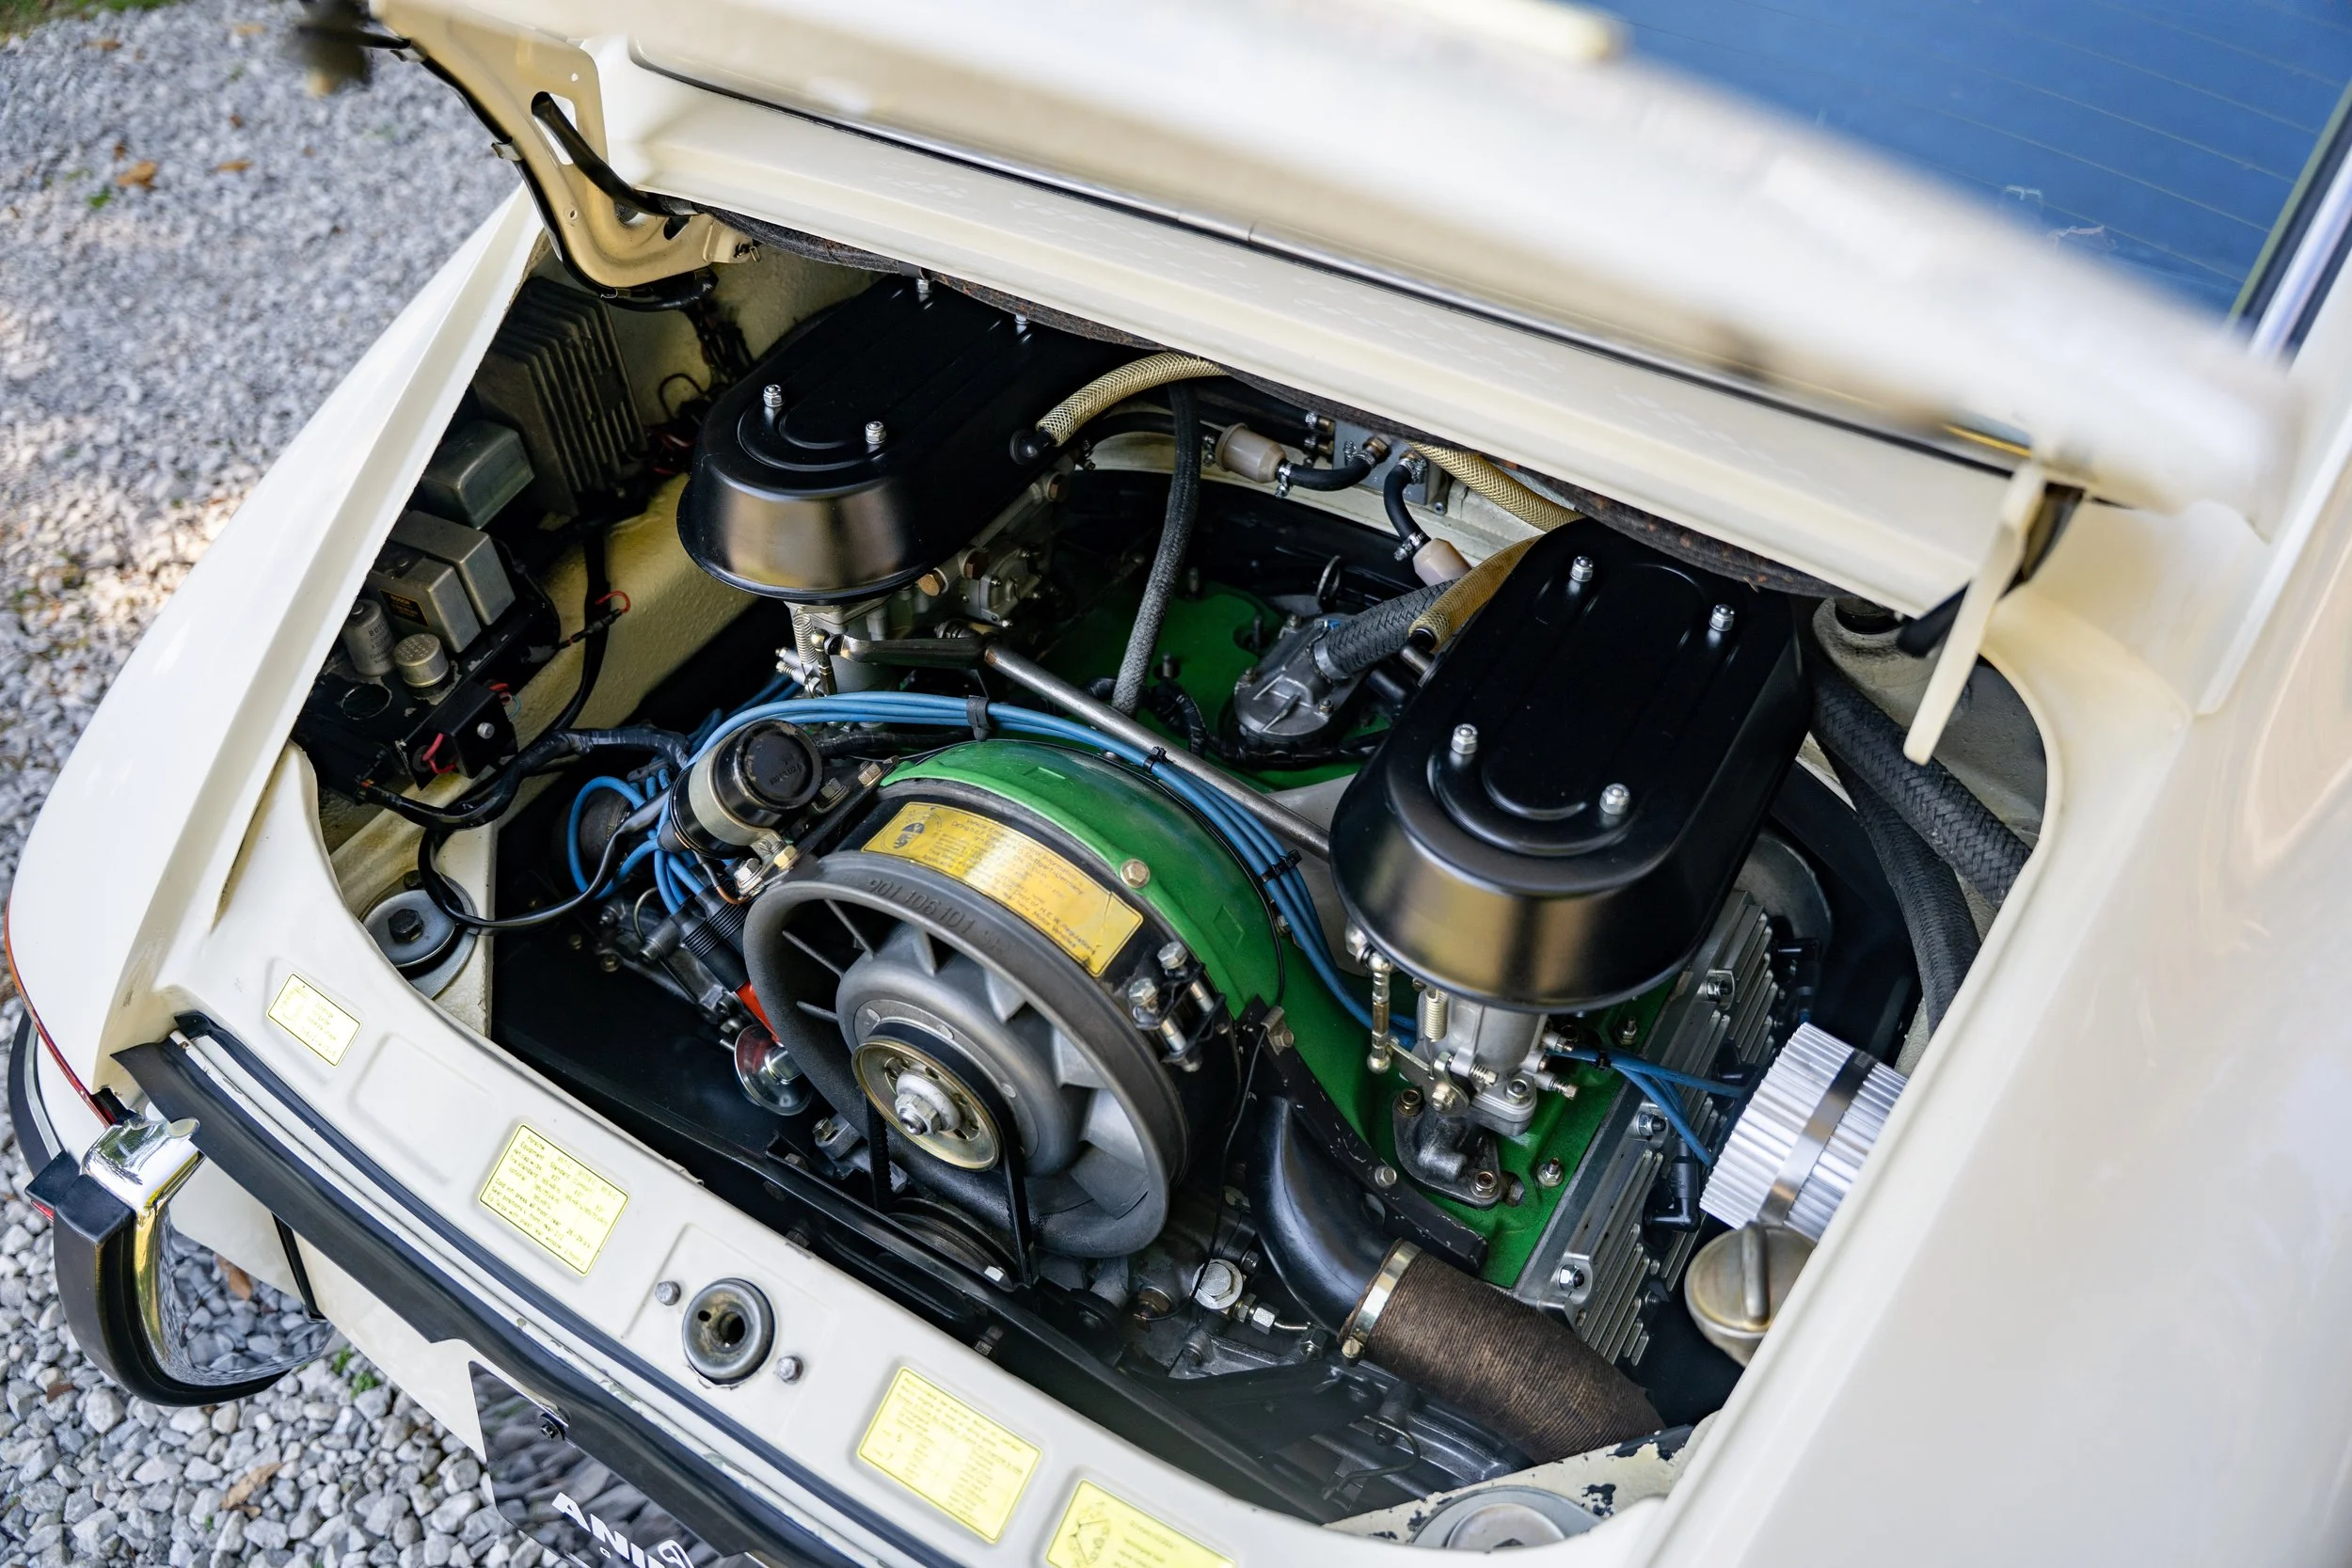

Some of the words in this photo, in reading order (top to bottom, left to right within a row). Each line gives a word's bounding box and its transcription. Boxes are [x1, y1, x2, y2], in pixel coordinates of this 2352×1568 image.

[868, 879, 903, 900] 901
[904, 889, 942, 916] 106
[938, 906, 976, 934] 101
